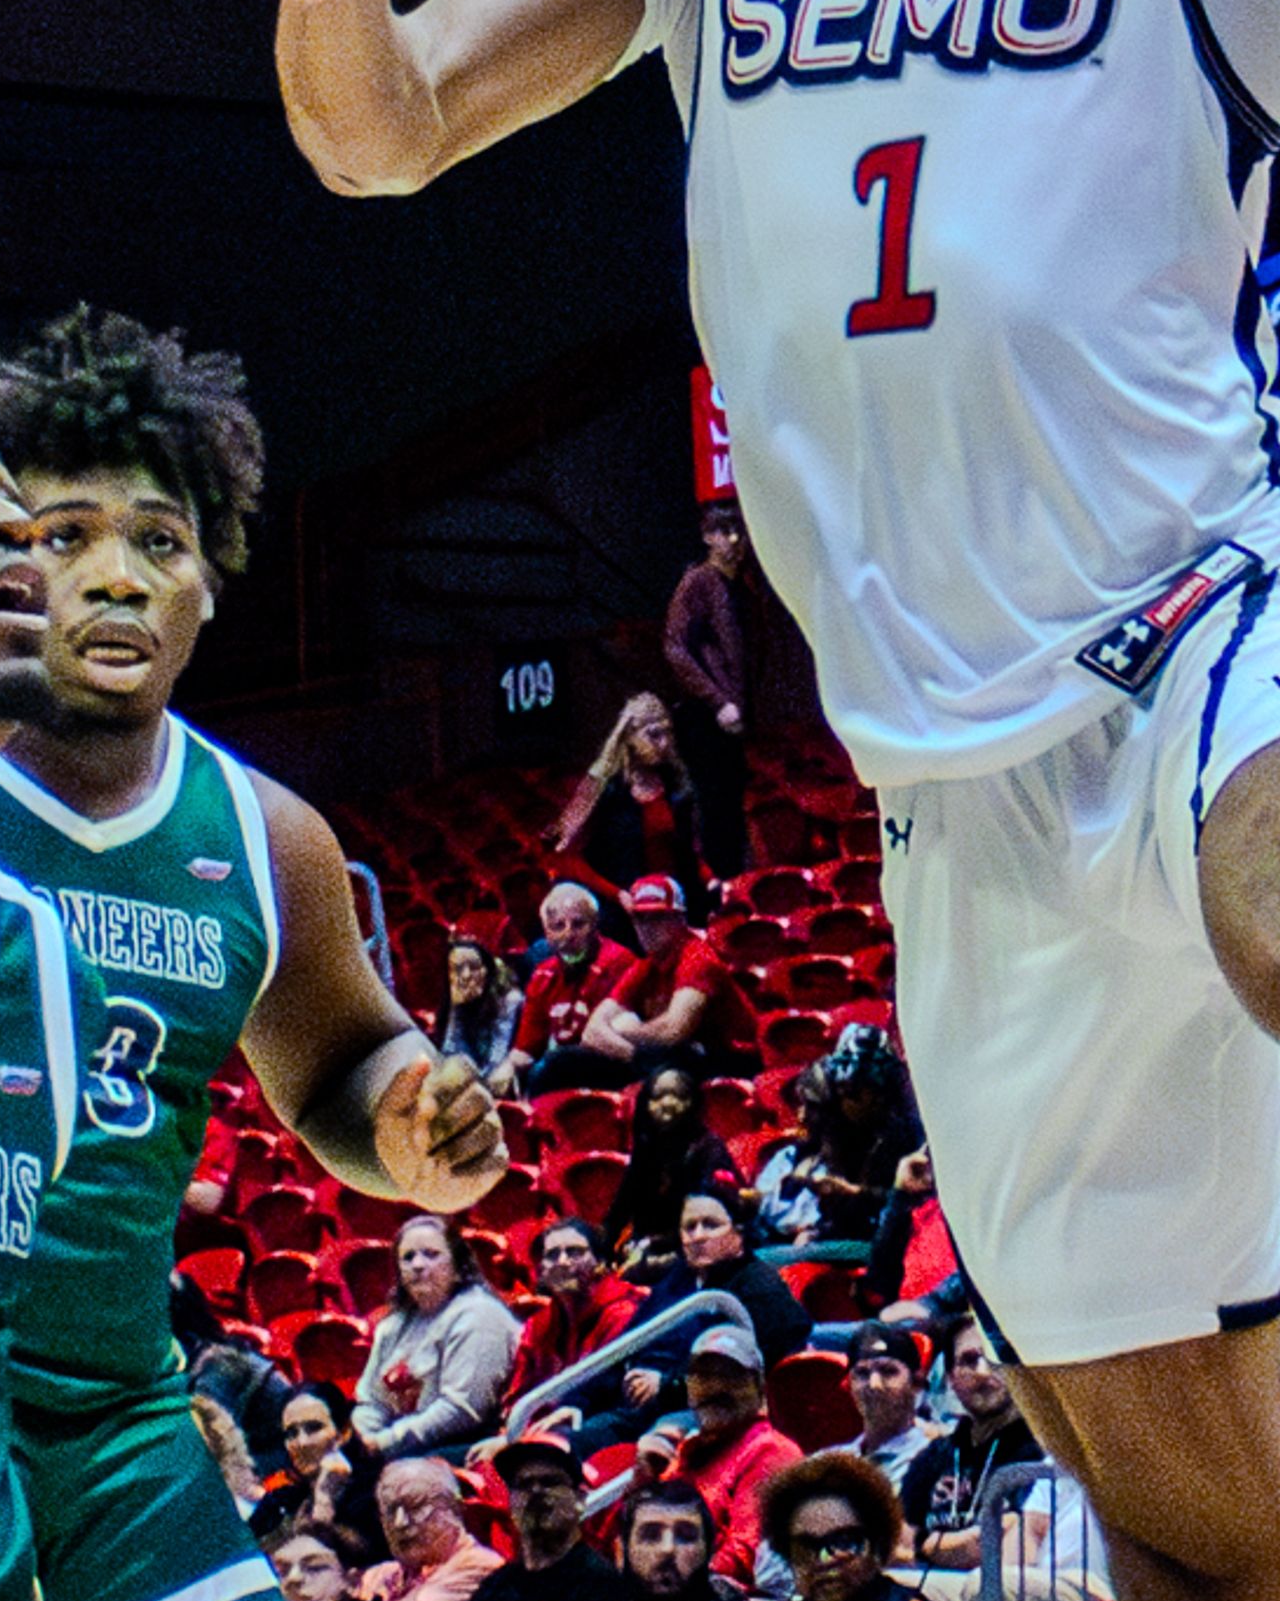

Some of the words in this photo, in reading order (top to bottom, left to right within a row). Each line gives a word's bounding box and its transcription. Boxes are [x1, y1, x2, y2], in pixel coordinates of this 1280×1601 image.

[846, 136, 936, 338] 1
[500, 659, 554, 713] 109
[82, 995, 168, 1139] 3
